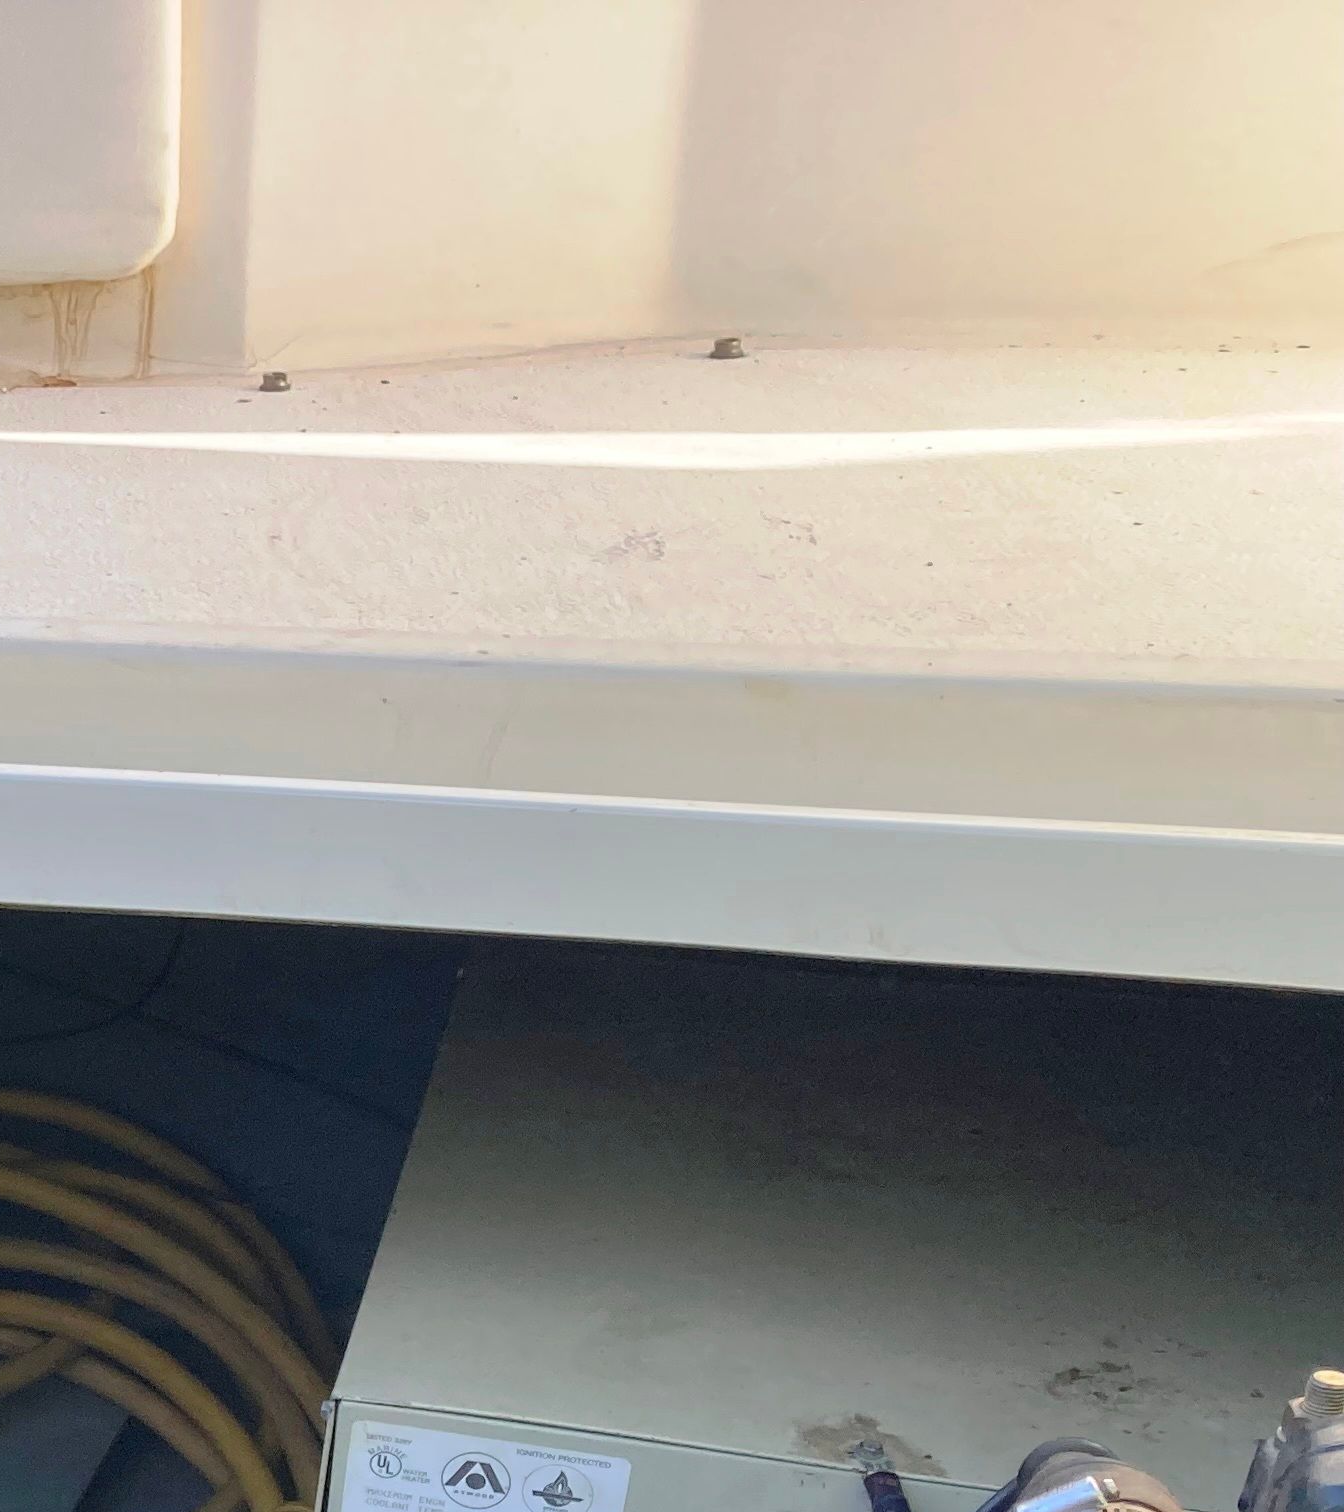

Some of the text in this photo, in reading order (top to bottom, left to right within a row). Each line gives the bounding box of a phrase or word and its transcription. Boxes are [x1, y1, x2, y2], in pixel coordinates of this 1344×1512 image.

[367, 1442, 408, 1459] MARINE
[516, 1448, 611, 1469] IGNITION PROTECTED
[375, 1454, 395, 1475] UL
